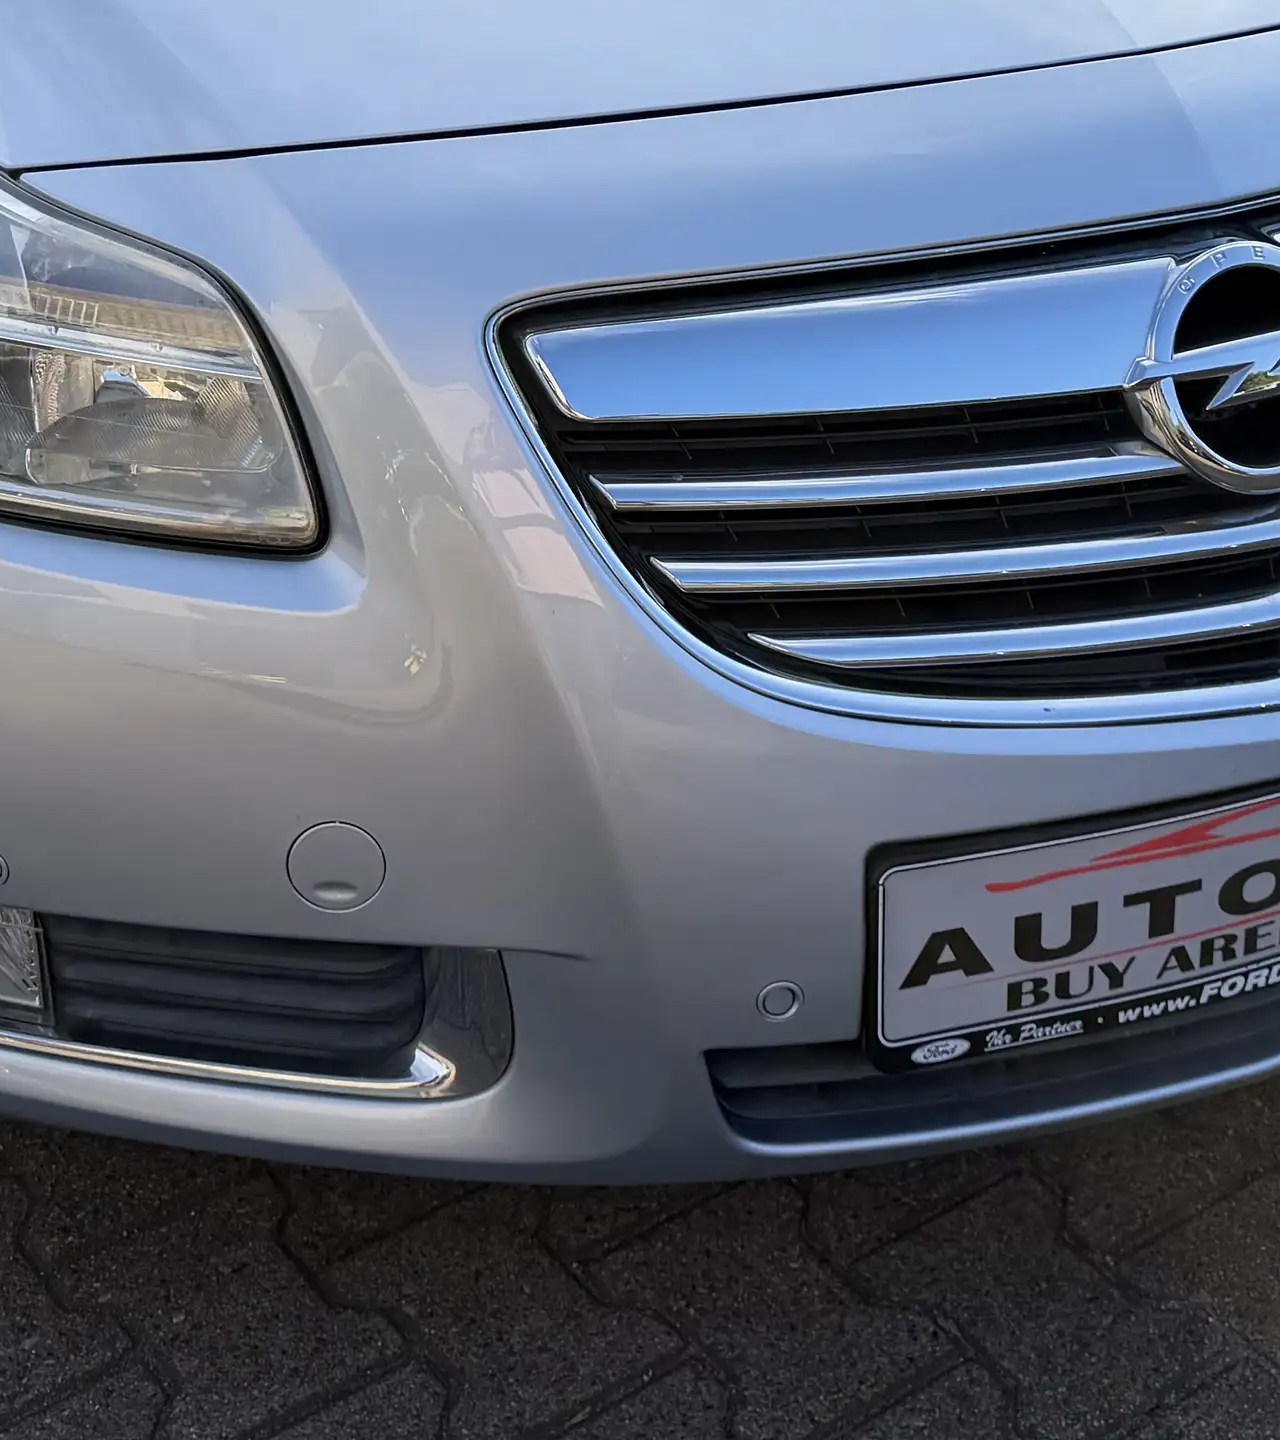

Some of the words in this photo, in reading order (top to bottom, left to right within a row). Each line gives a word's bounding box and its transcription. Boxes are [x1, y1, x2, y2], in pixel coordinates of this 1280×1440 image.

[1006, 956, 1136, 1012] BUY
[985, 1029, 1013, 1050] Ihr
[1019, 1018, 1084, 1042] Partner
